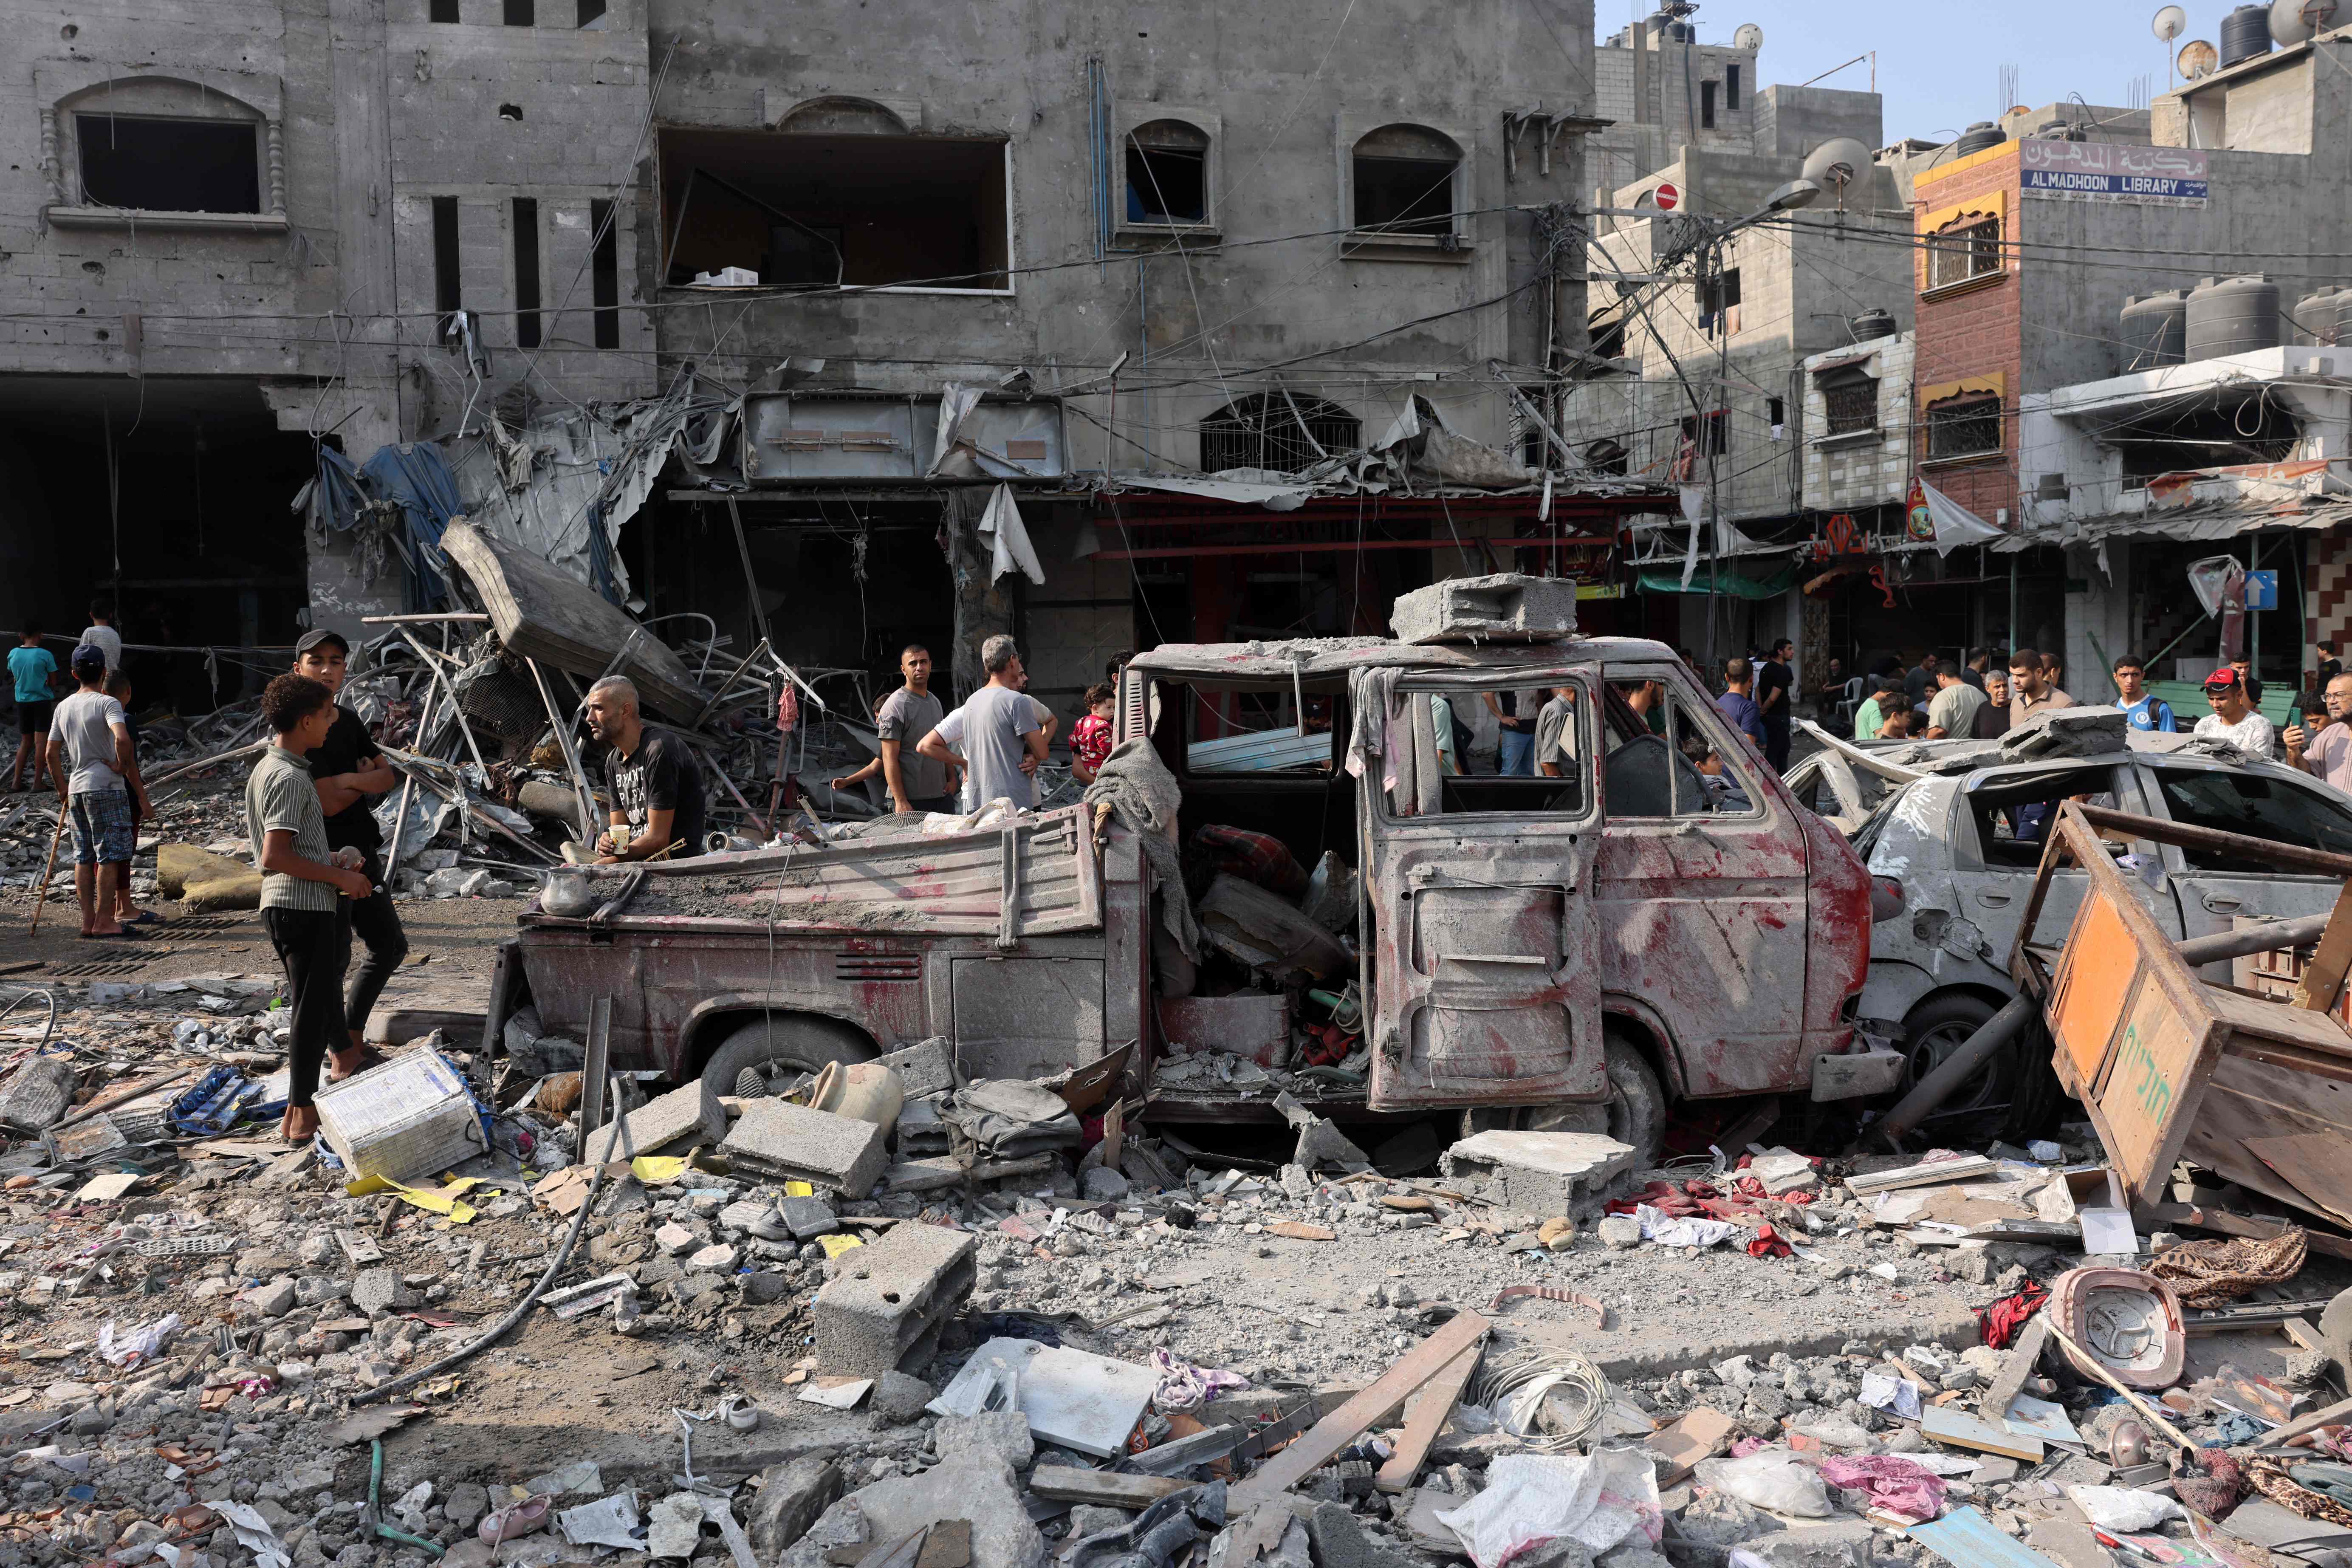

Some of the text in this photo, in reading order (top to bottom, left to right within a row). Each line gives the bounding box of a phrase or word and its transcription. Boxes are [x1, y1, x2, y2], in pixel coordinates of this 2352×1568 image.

[2026, 143, 2203, 176] مكتبة المدهون
[2122, 176, 2178, 194] LIBRARY
